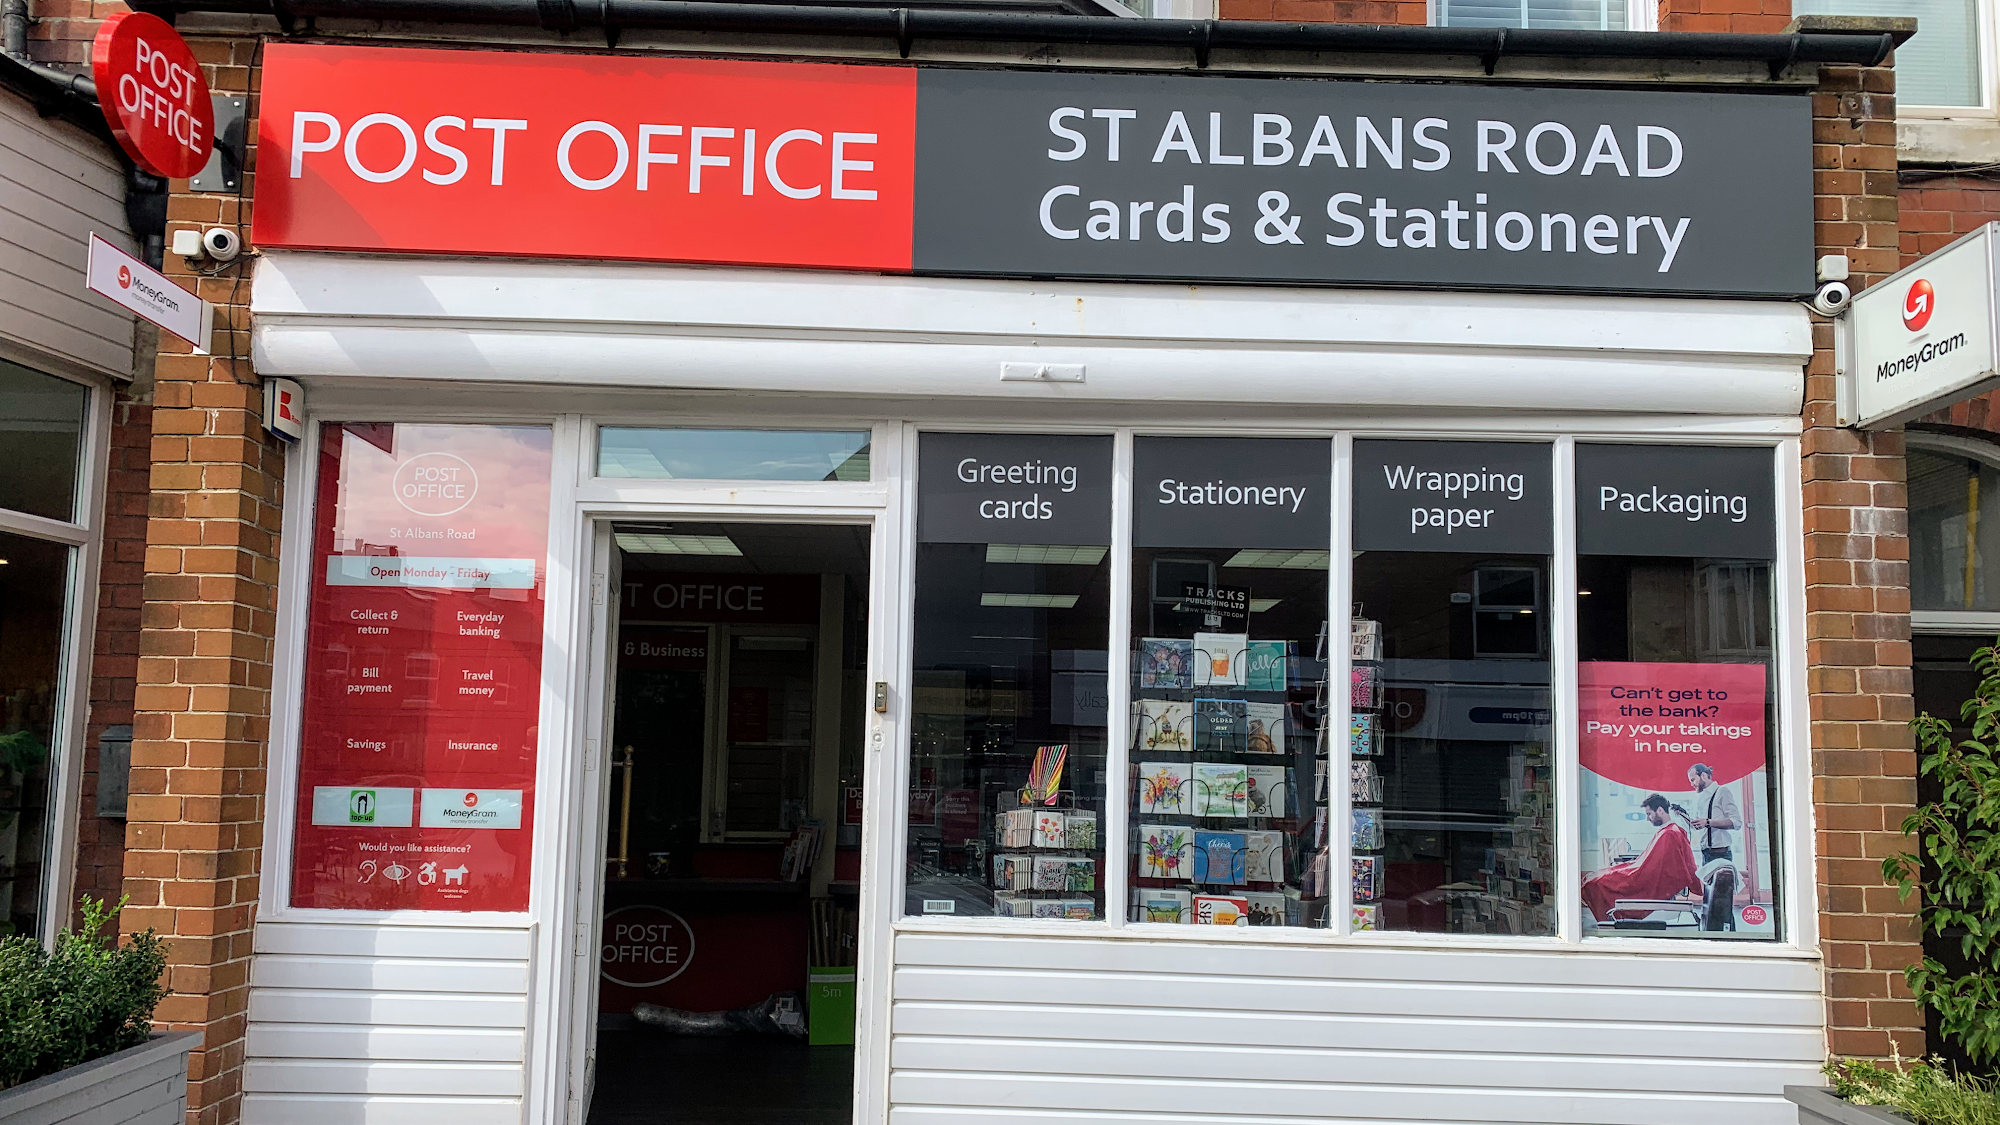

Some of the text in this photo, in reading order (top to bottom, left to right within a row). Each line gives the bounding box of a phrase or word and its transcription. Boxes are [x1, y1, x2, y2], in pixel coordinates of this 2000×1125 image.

[136, 37, 196, 106] POST
[119, 73, 202, 155] OFFICE
[1047, 107, 1684, 178] ST ALBANS ROAD
[290, 111, 878, 201] POST OFFICE
[1039, 184, 1691, 273] Cards & Stationery
[415, 467, 460, 482] POST
[957, 458, 1078, 493] Greeting
[1383, 464, 1525, 500] Wrapping
[403, 483, 465, 499] OFFICE
[1159, 478, 1306, 513] Stationery
[979, 493, 1053, 520] cards
[1600, 486, 1748, 523] Packaging
[1411, 504, 1495, 534] paper
[390, 527, 475, 540] St Albans Road
[370, 566, 400, 580] Open
[403, 567, 447, 581] Monday
[457, 567, 491, 581] Friday
[653, 583, 764, 611] OFFICE
[1186, 586, 1245, 601] TRACKS
[1185, 597, 1245, 610] PUBLISHING LTD
[350, 609, 398, 620] Collect &
[457, 611, 505, 625] Everyday
[357, 625, 389, 635] return
[459, 625, 500, 639] banking
[624, 641, 705, 658] & Business
[362, 667, 379, 678] Bill
[462, 669, 493, 680] Travel
[347, 684, 392, 695] payment
[459, 686, 495, 698] money
[1610, 686, 1728, 703] Can't get to
[1619, 704, 1719, 718] the bank?
[1586, 720, 1752, 740] Pay your takings
[347, 738, 386, 752] Savings
[448, 739, 498, 750] Insurance
[1634, 739, 1707, 753] in here.
[910, 792, 933, 802] yday
[351, 814, 373, 822] top-up
[359, 842, 471, 854] Would you like assistance?
[615, 924, 672, 942] POST
[601, 945, 678, 964] OFFICE
[822, 986, 841, 998] 5m
